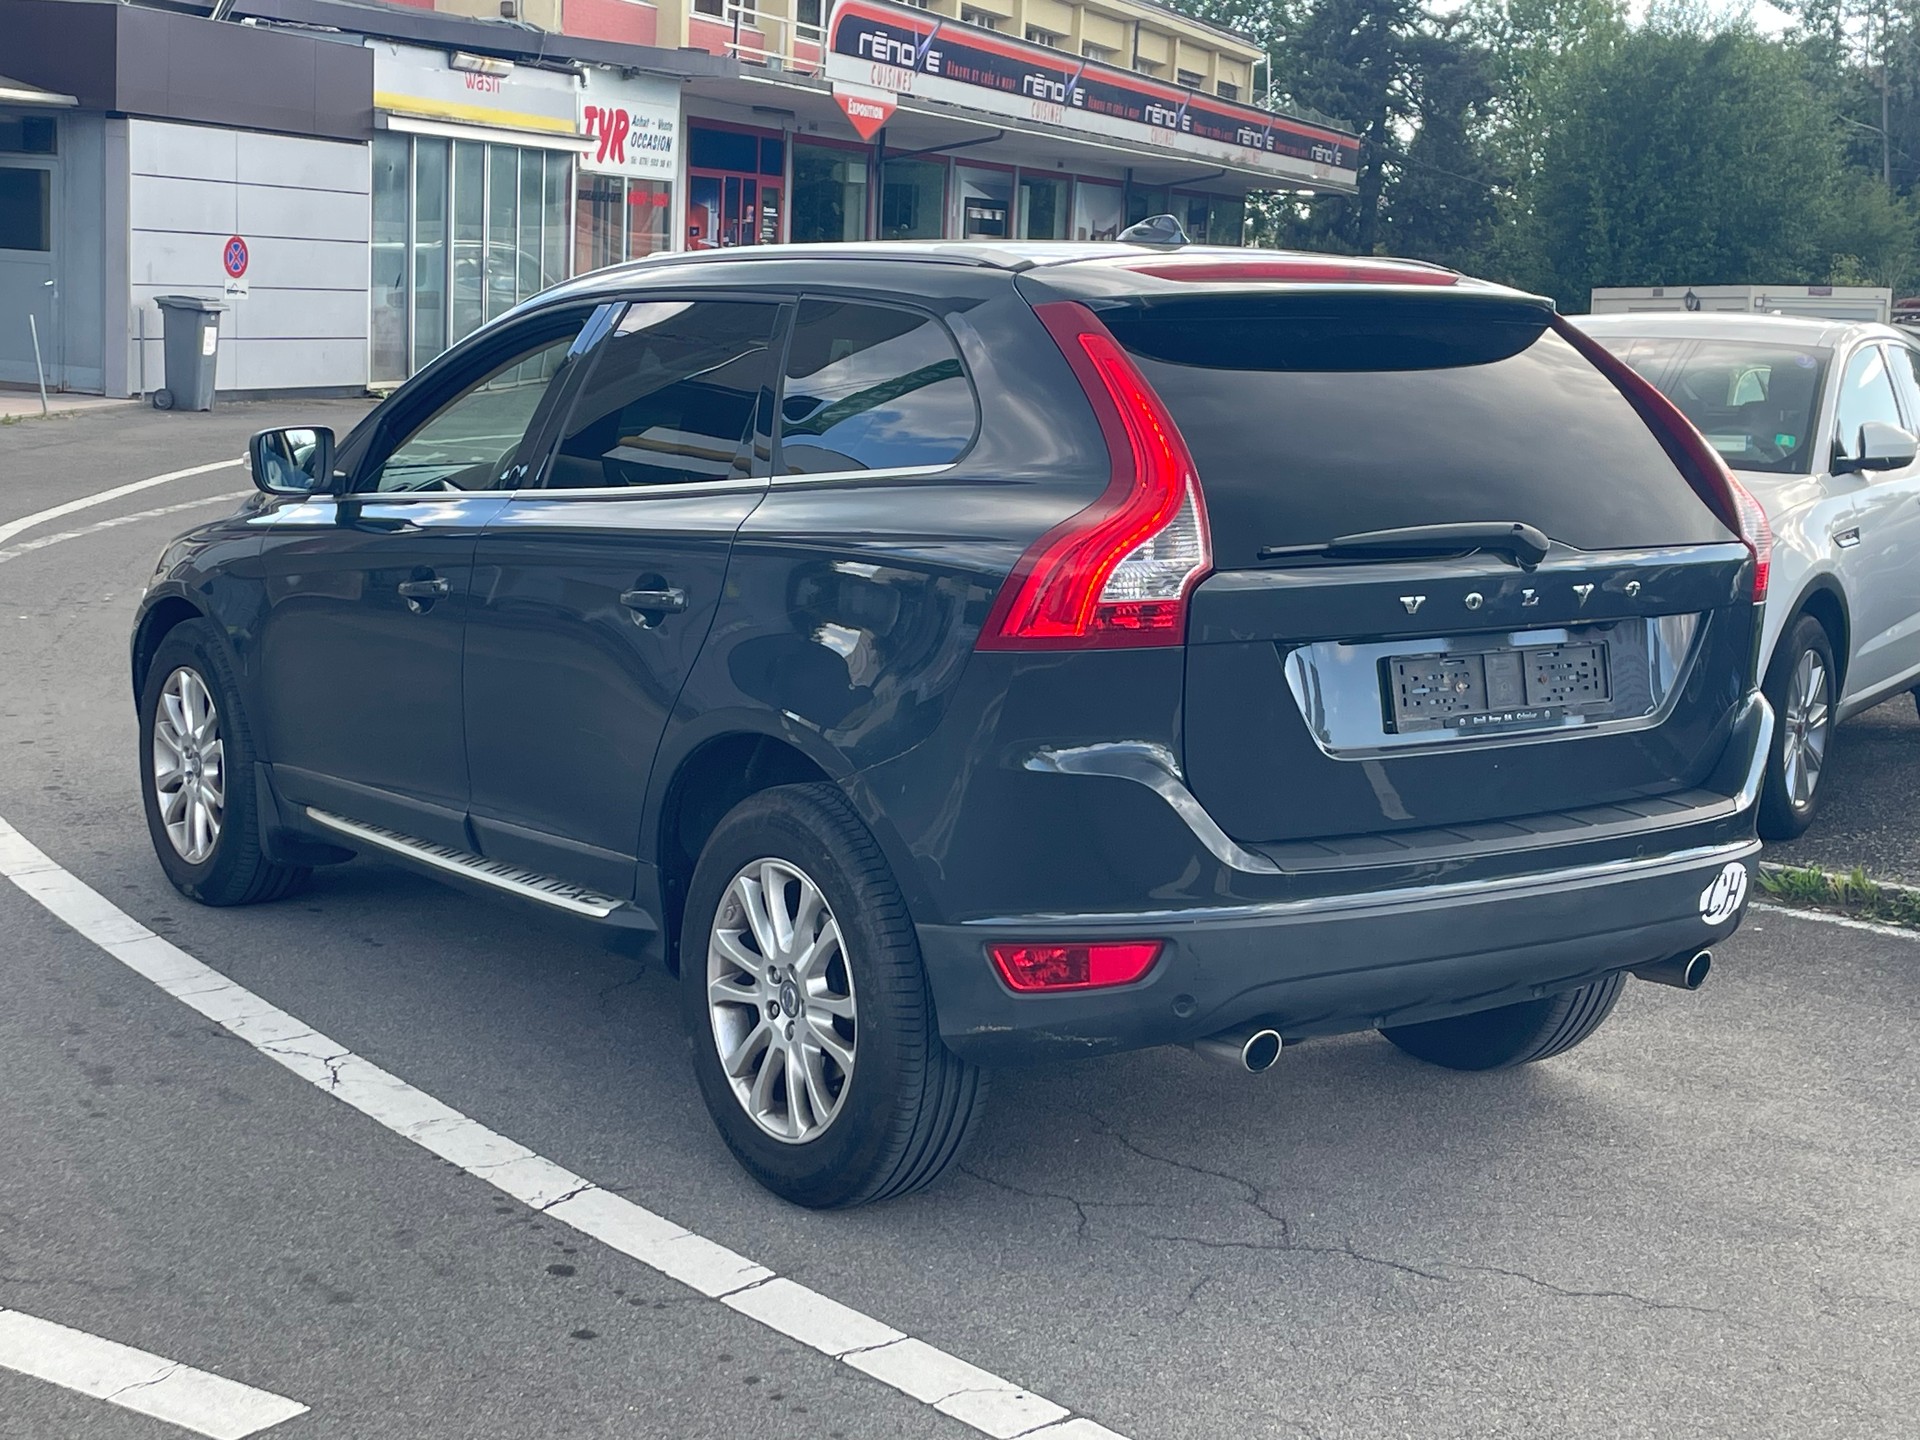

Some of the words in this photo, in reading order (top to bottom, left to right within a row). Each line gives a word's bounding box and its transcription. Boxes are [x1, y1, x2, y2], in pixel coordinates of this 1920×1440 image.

[871, 64, 913, 91] CUISINES
[583, 106, 630, 164] TYR
[630, 132, 673, 152] OCCASION
[1400, 580, 1641, 614] VOLVO
[1704, 870, 1743, 917] CH
